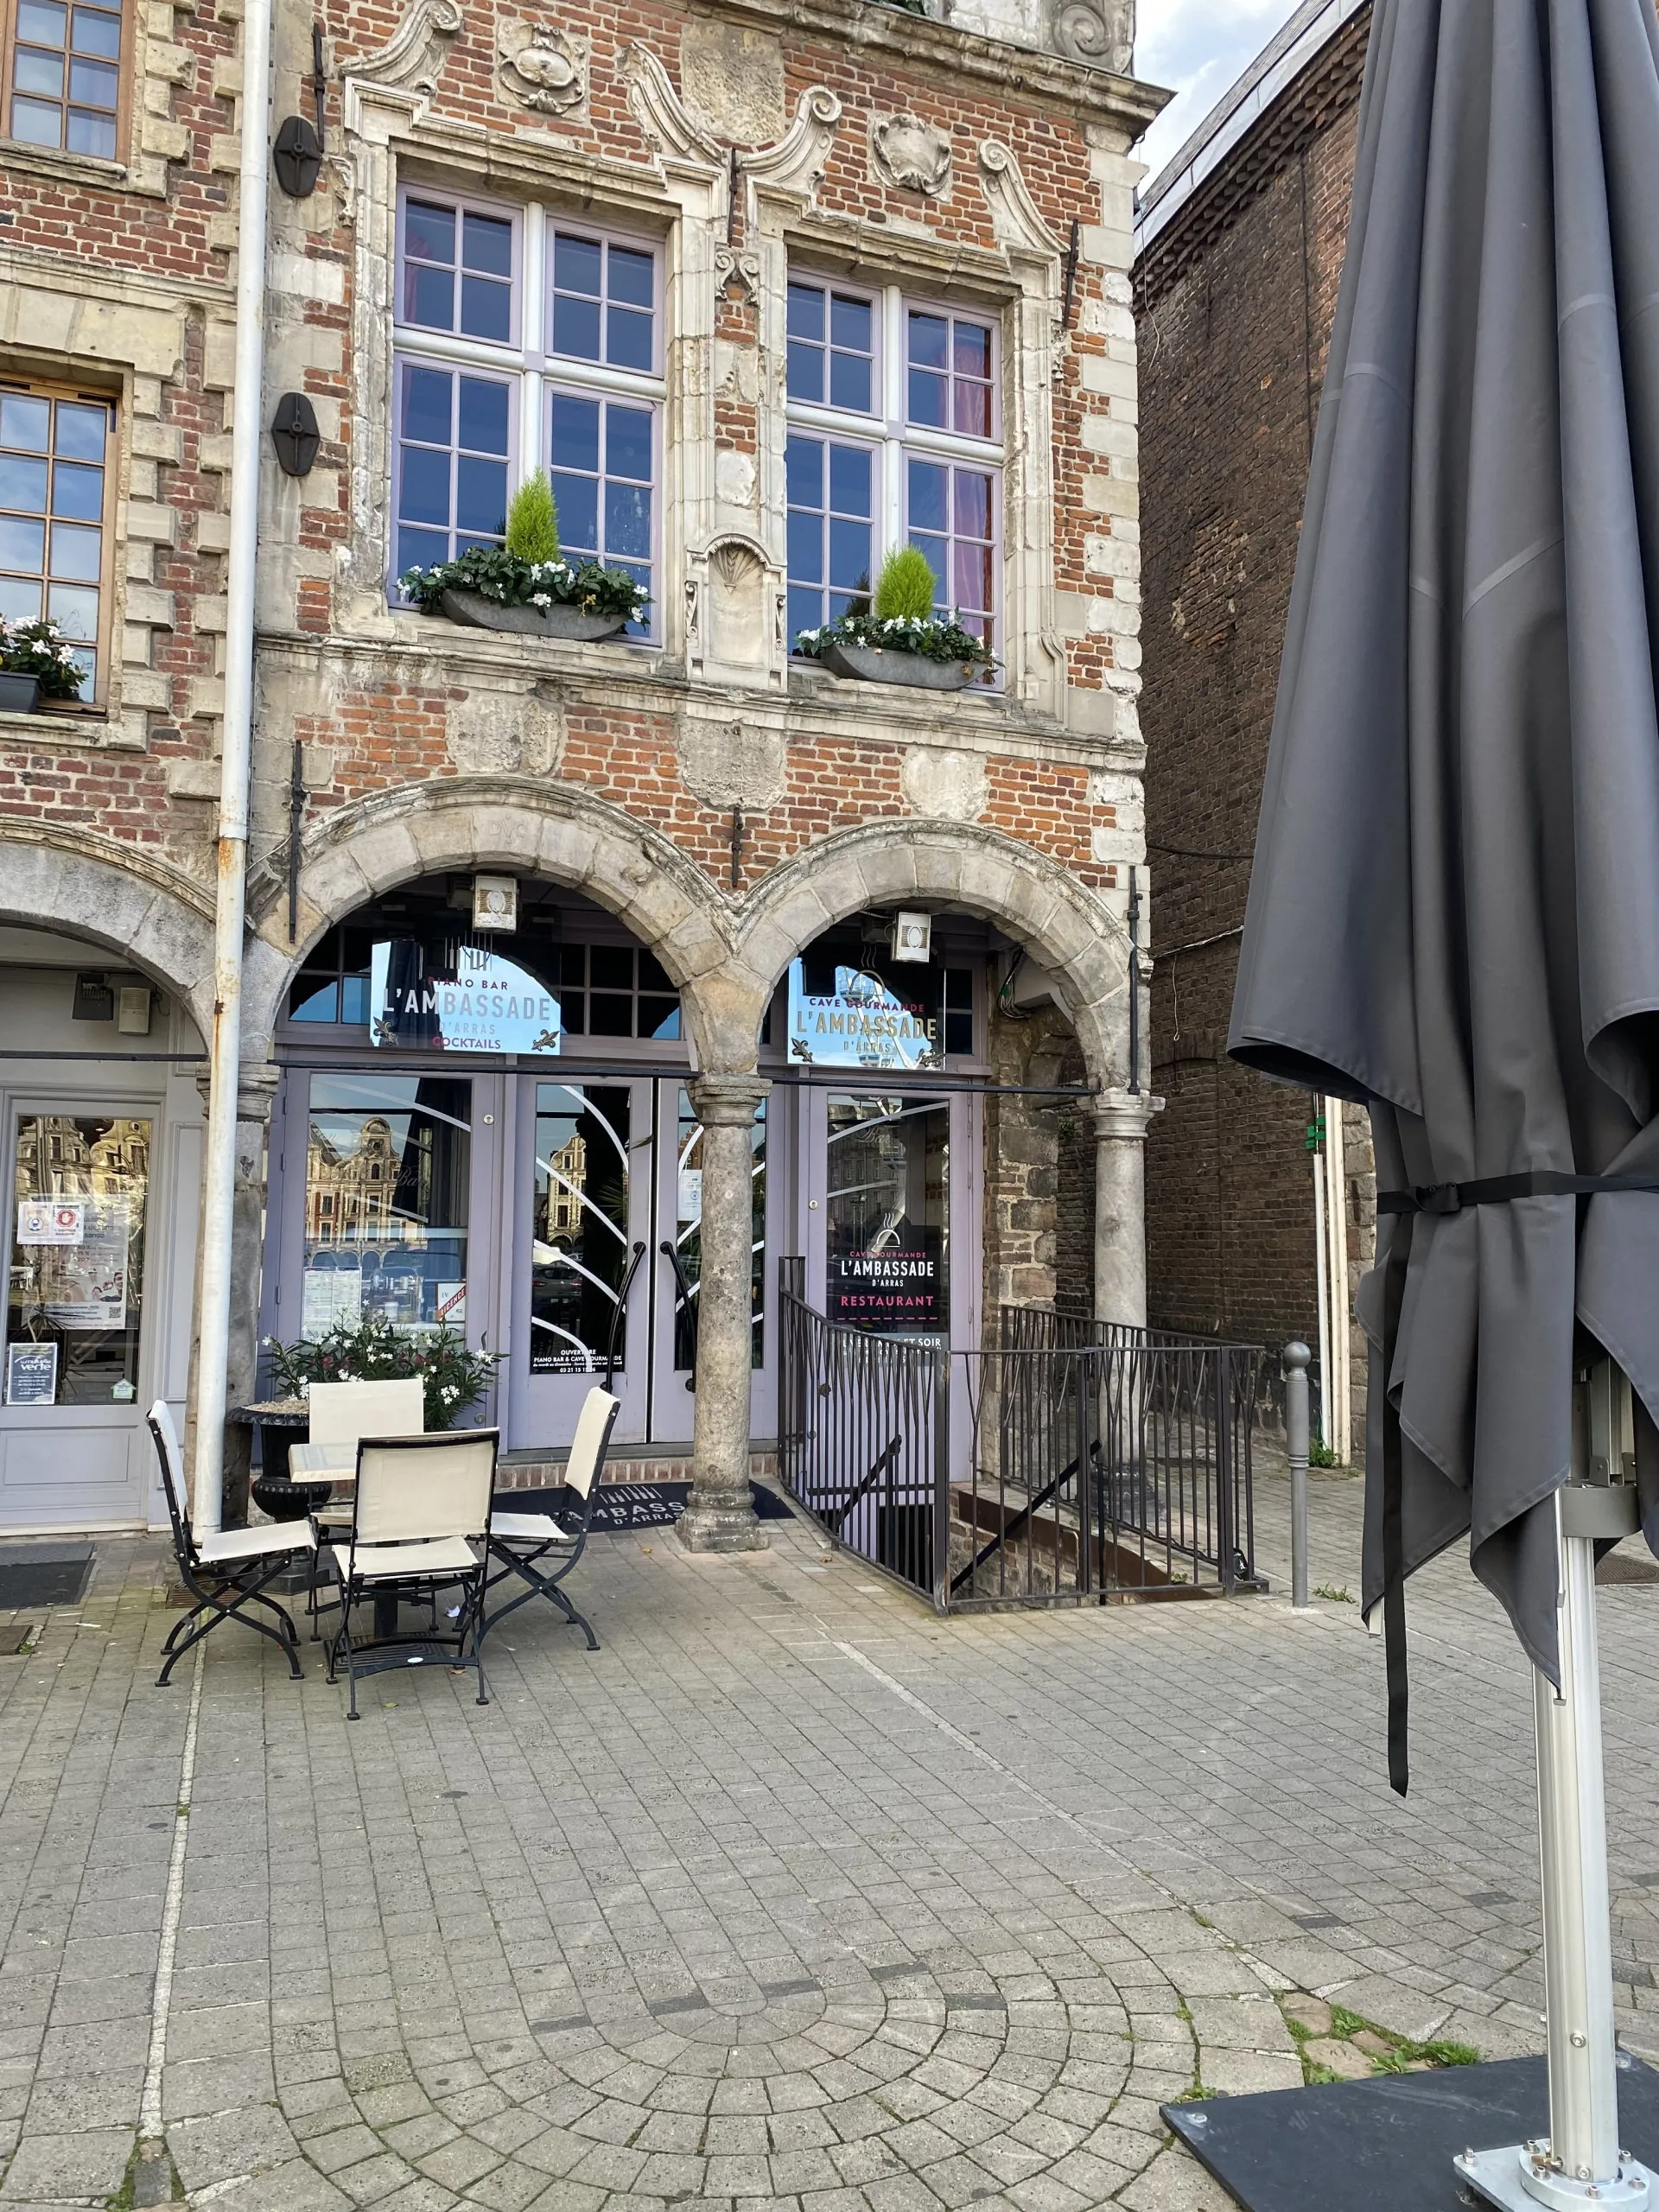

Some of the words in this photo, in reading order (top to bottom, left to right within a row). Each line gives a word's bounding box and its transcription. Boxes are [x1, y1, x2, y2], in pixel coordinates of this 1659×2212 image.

[428, 976, 474, 988] PIANO
[481, 980, 508, 990] BAR
[383, 988, 550, 1020] L'AMBASSADE
[810, 997, 841, 1007] CAVE
[846, 1000, 925, 1013] GOURMANDE
[439, 1020, 495, 1035] D'ARRAS
[797, 1011, 937, 1040] L'AMBASSADE
[432, 1036, 501, 1050] COCKTAILS
[843, 1040, 891, 1053] D'ARRAS
[841, 1261, 934, 1276] L'AMBASSADE
[841, 1296, 933, 1306] RESTAURANT
[918, 1338, 941, 1347] SOIR
